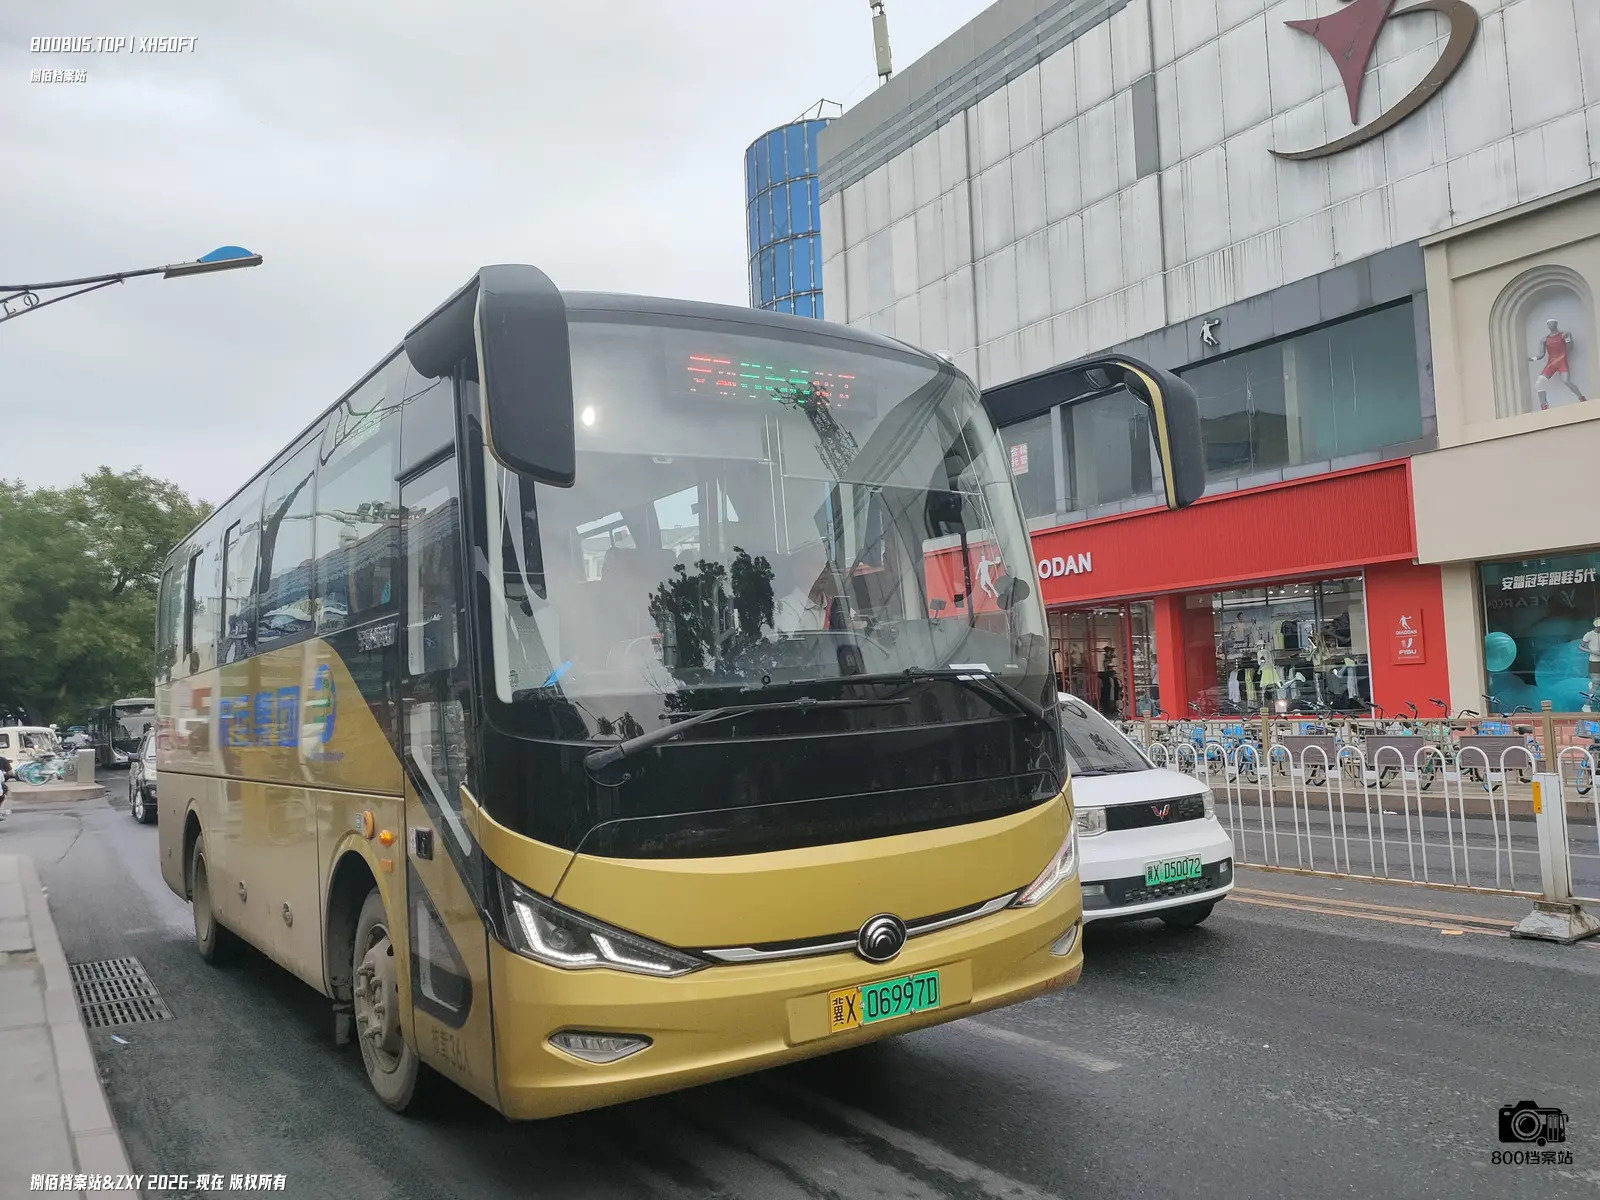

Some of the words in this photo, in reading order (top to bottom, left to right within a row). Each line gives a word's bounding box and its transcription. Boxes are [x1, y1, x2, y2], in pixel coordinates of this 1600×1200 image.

[1037, 551, 1092, 579] ODAN
[1501, 567, 1596, 591] 安踏冠军跑鞋5代
[1164, 857, 1201, 880] D50072
[832, 993, 857, 1026] 冀X
[867, 976, 938, 1018] 06997D
